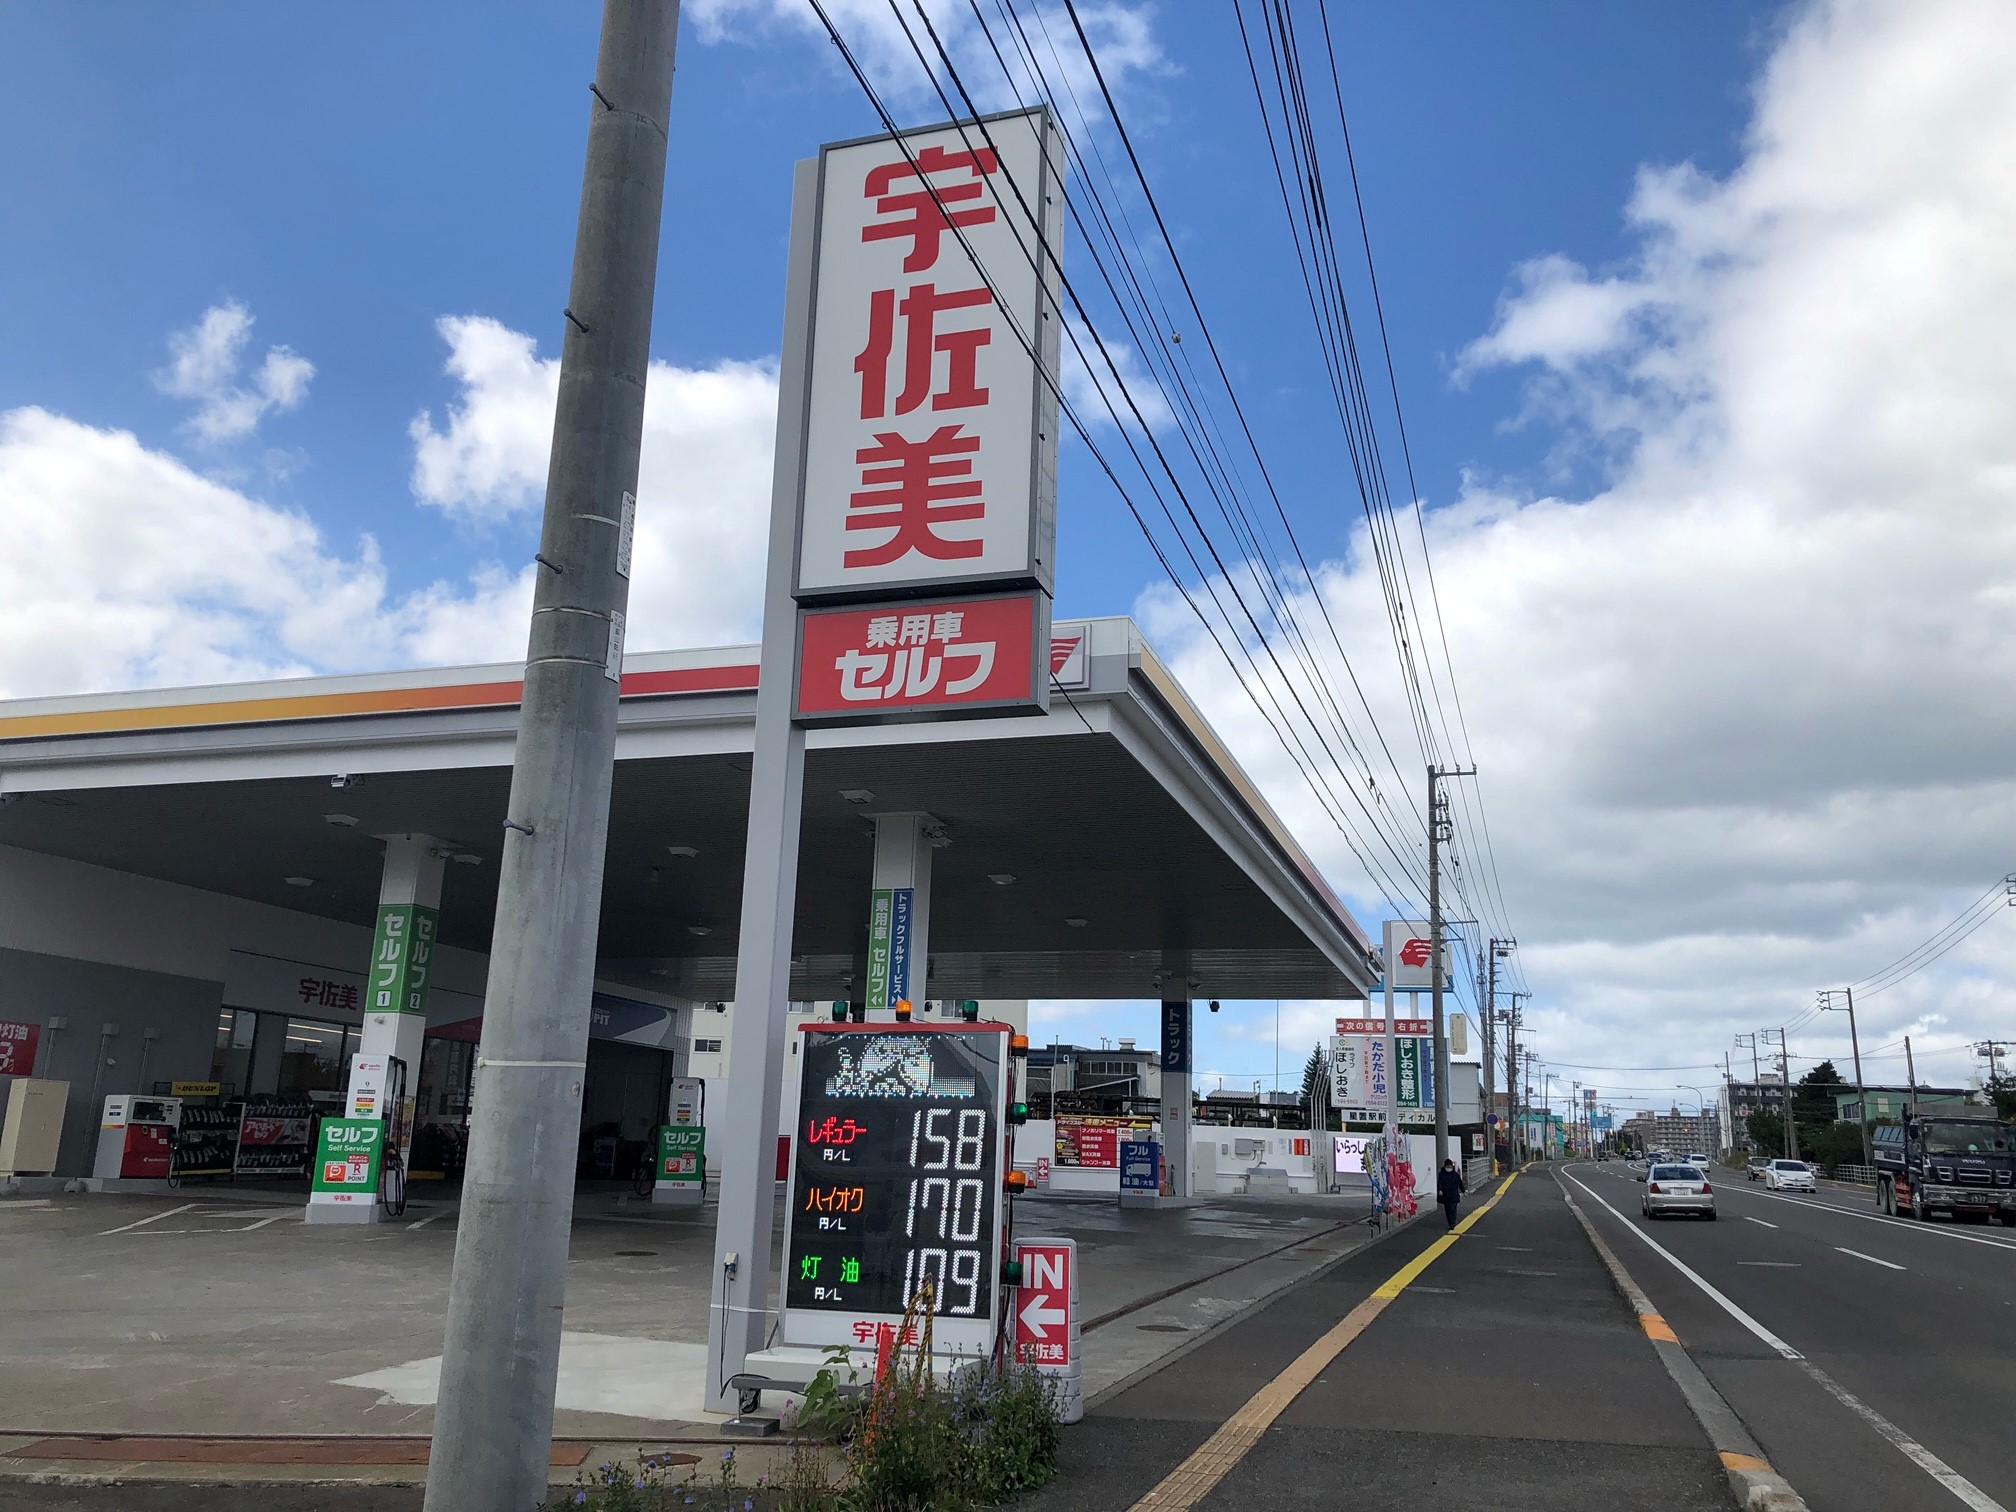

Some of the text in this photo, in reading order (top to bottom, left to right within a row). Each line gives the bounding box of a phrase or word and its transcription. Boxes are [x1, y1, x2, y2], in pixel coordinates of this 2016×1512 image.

[843, 145, 998, 569] 宇佐美
[866, 611, 963, 650] 乗用車
[835, 641, 996, 701] セルフ
[378, 913, 404, 987] セルフ
[411, 915, 432, 988] セルフ
[872, 898, 889, 992] 乗用車 セルフ
[299, 978, 358, 1011] 宇佐美
[0, 1022, 29, 1041] 灯油
[1168, 1008, 1180, 1065] トラック
[1335, 1052, 1348, 1098] ほしおき
[326, 1125, 378, 1144] セルフ
[664, 1131, 702, 1145] セルフ
[810, 1116, 867, 1144] レギュラー
[909, 1108, 987, 1171] 158
[328, 1144, 371, 1152] Self Service
[823, 1148, 851, 1162] 円/L
[1039, 1159, 1048, 1167] IN
[1128, 1145, 1149, 1156] フル
[1336, 1140, 1365, 1155] いらっし
[805, 1186, 863, 1213] ハイオク
[906, 1177, 984, 1242] 170
[819, 1217, 846, 1231] 円/L
[902, 1248, 981, 1315] 109
[1023, 1253, 1064, 1290] IN
[814, 1286, 842, 1301] 円/L
